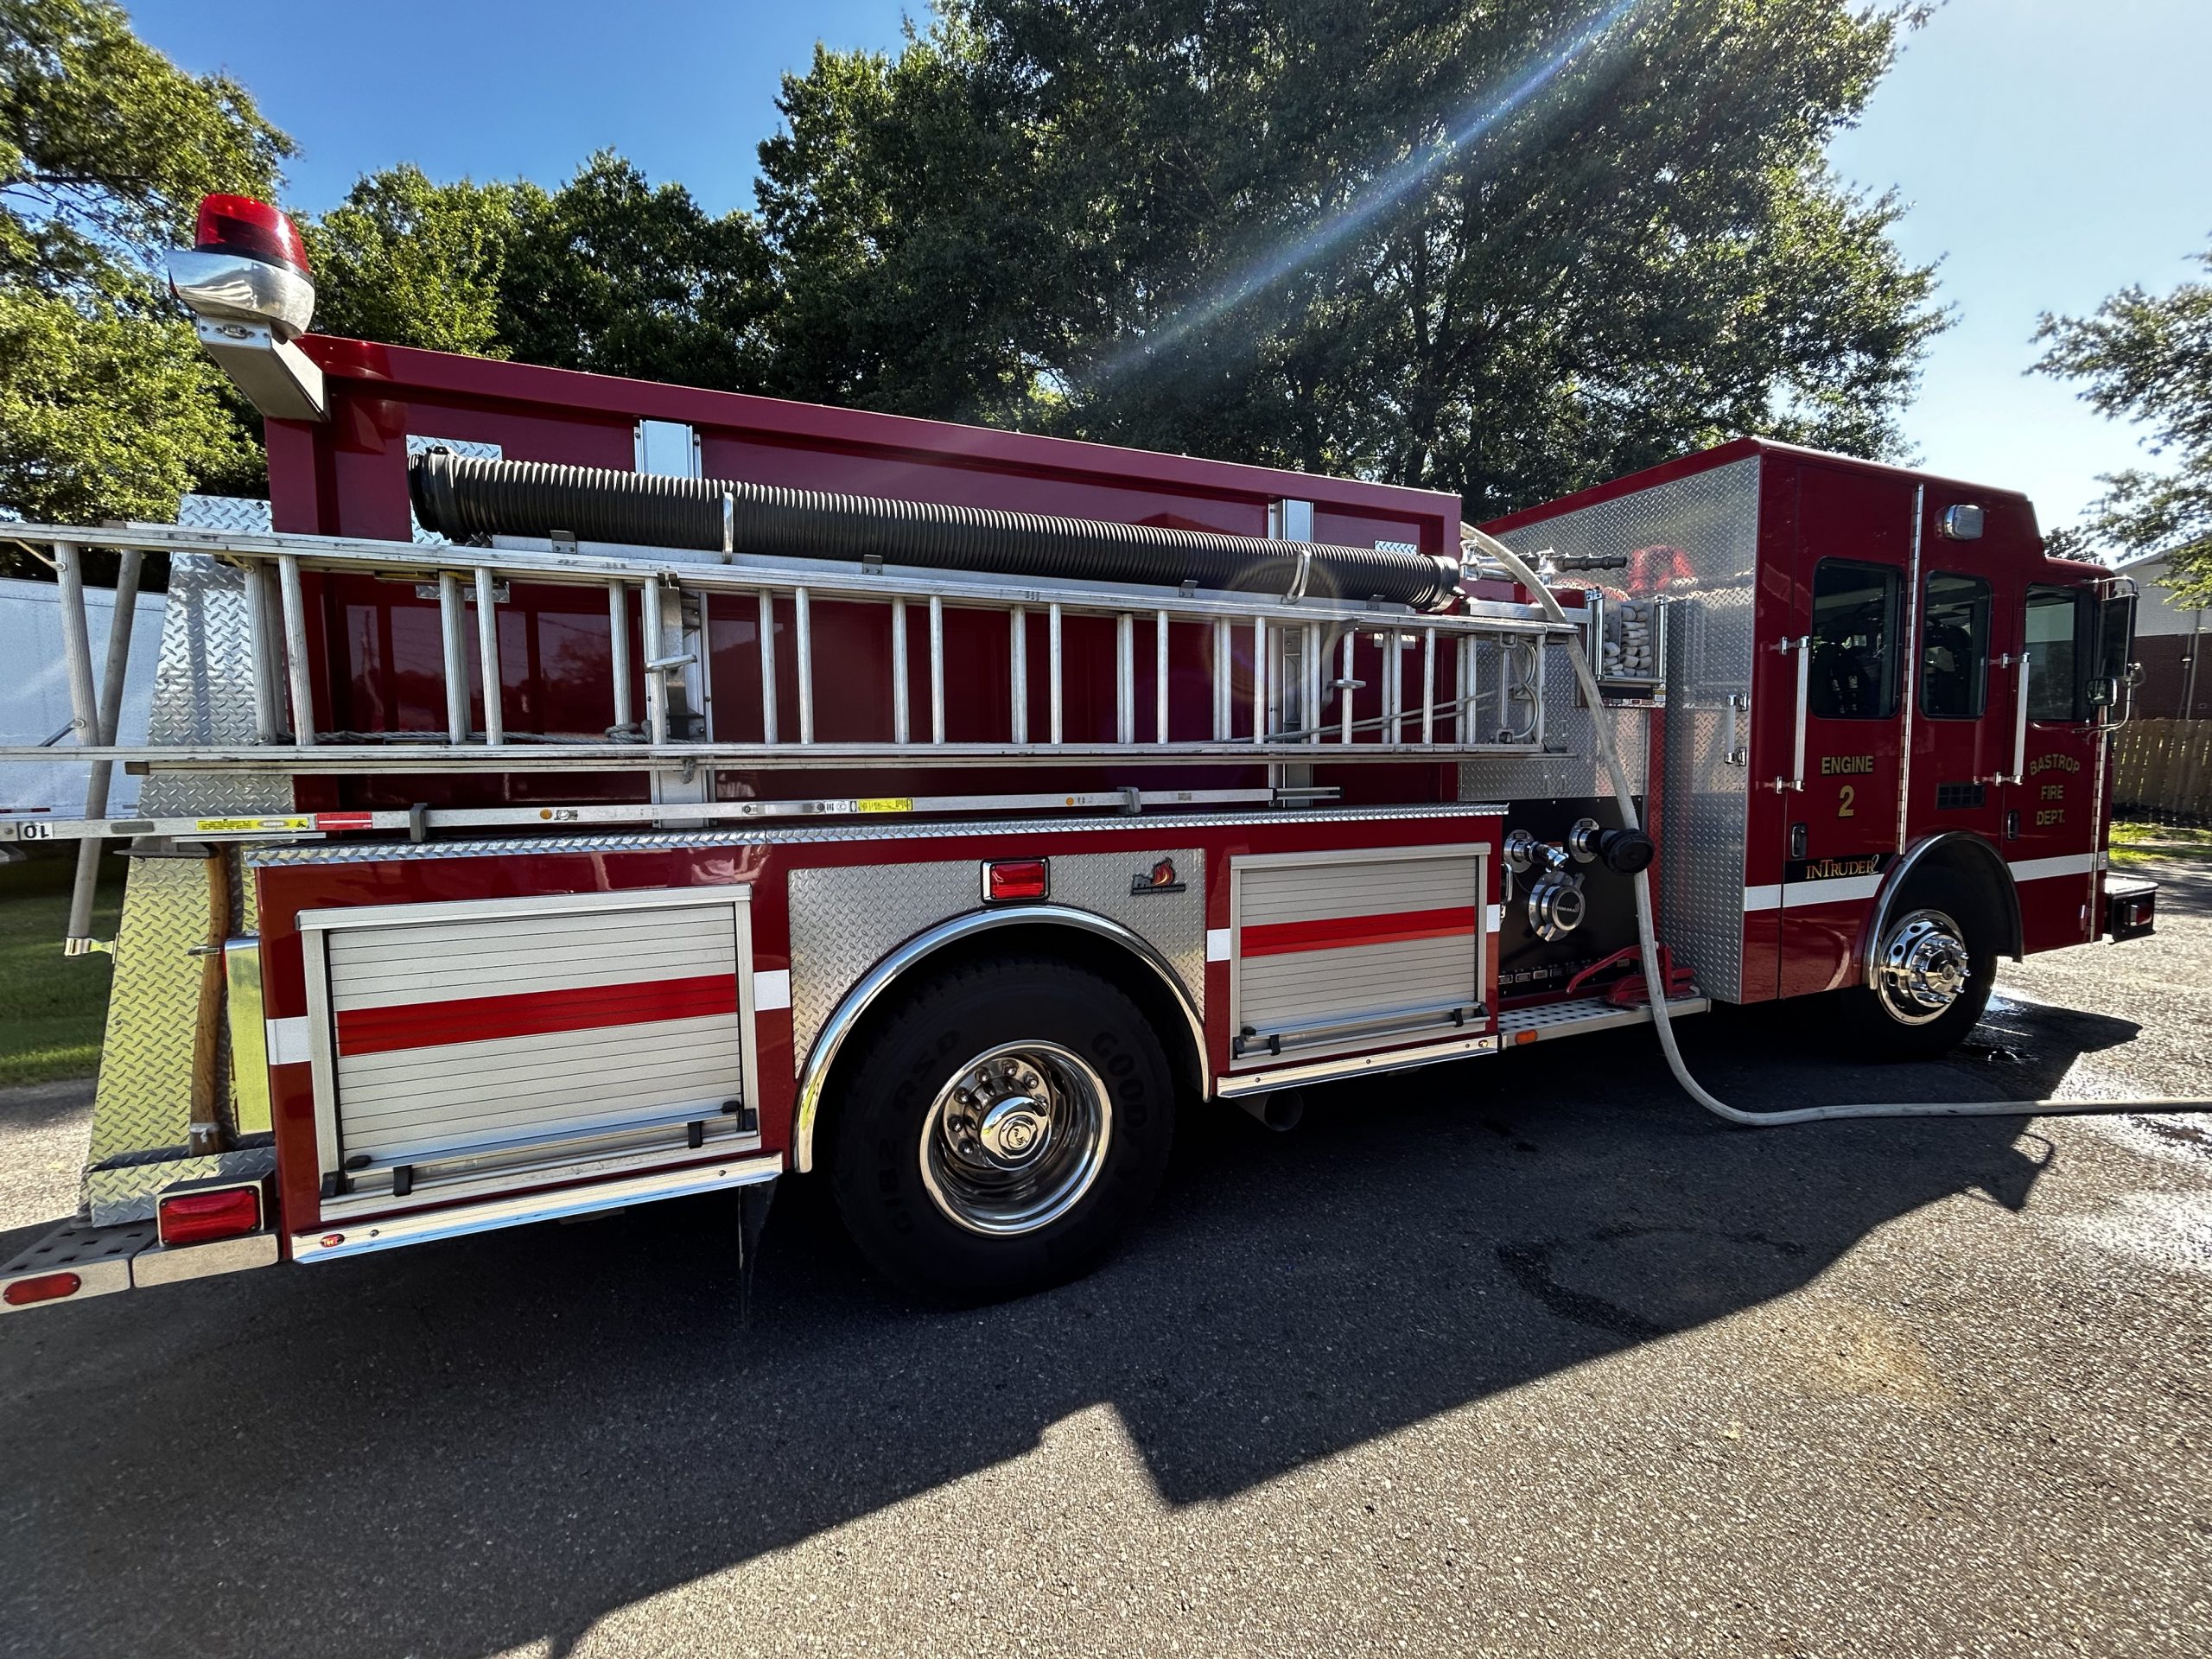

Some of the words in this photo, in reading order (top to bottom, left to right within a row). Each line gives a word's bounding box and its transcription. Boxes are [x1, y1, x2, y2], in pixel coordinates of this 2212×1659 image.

[1821, 755, 1874, 775] ENGINE
[2030, 753, 2081, 776] BASTROP
[1838, 785, 1855, 817] 2
[2040, 785, 2065, 800] FIRE
[2036, 809, 2066, 826] DEPT.
[23, 824, 49, 839] 10
